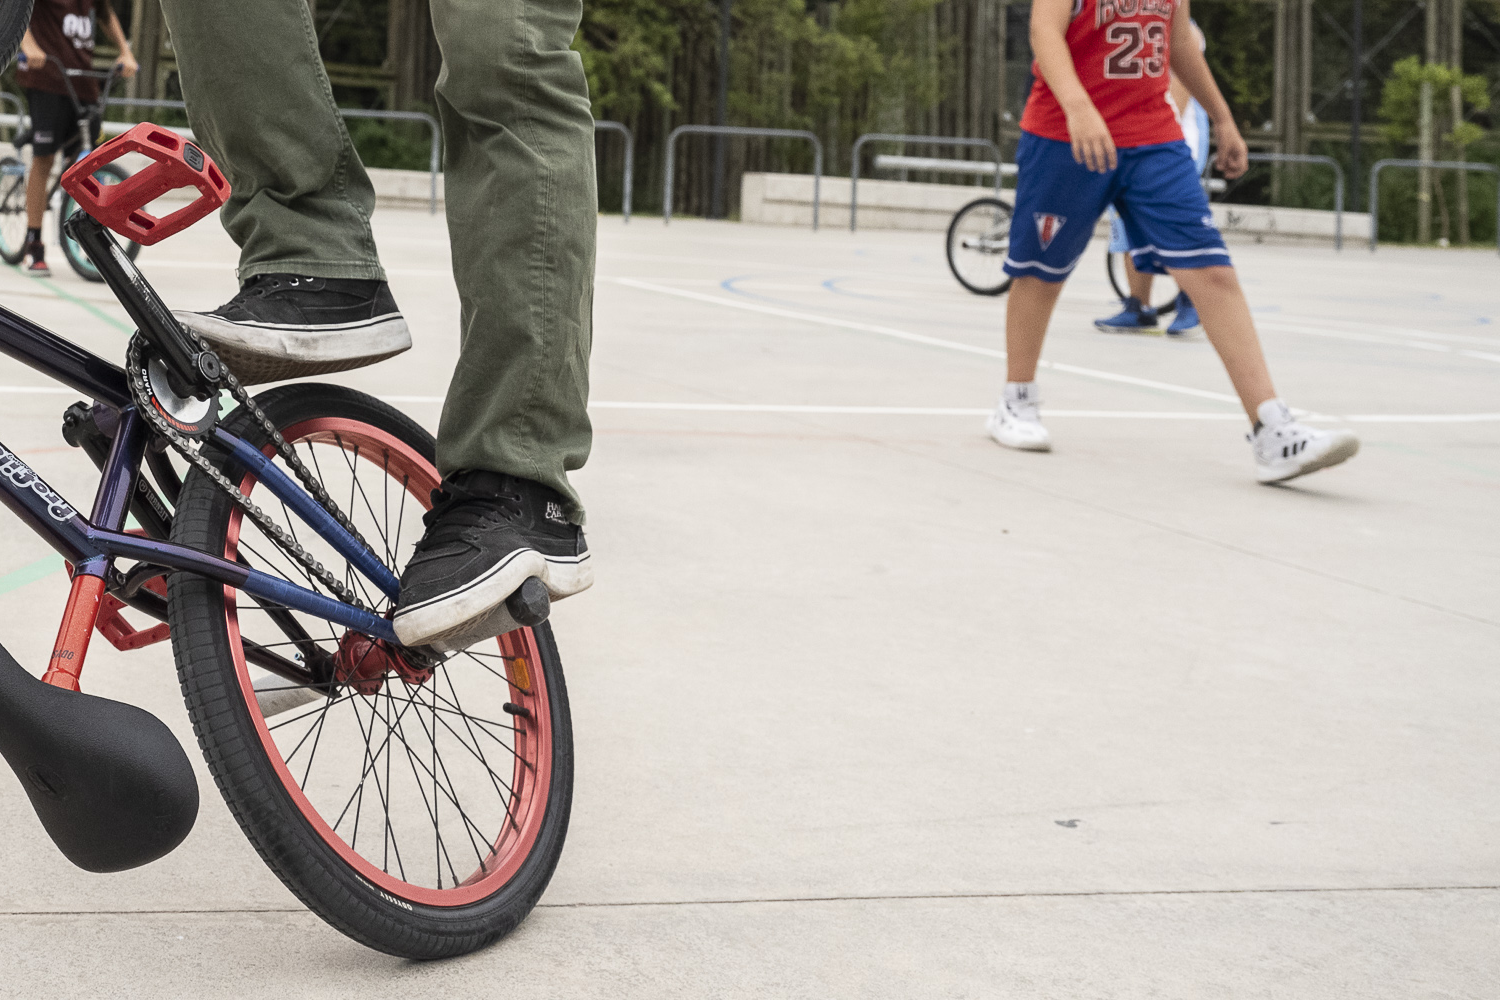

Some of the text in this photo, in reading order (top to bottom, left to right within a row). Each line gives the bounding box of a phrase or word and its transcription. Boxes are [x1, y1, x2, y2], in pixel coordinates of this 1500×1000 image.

[1104, 21, 1167, 79] 23
[141, 368, 154, 396] HARO
[380, 891, 413, 911] ODYSSEY
